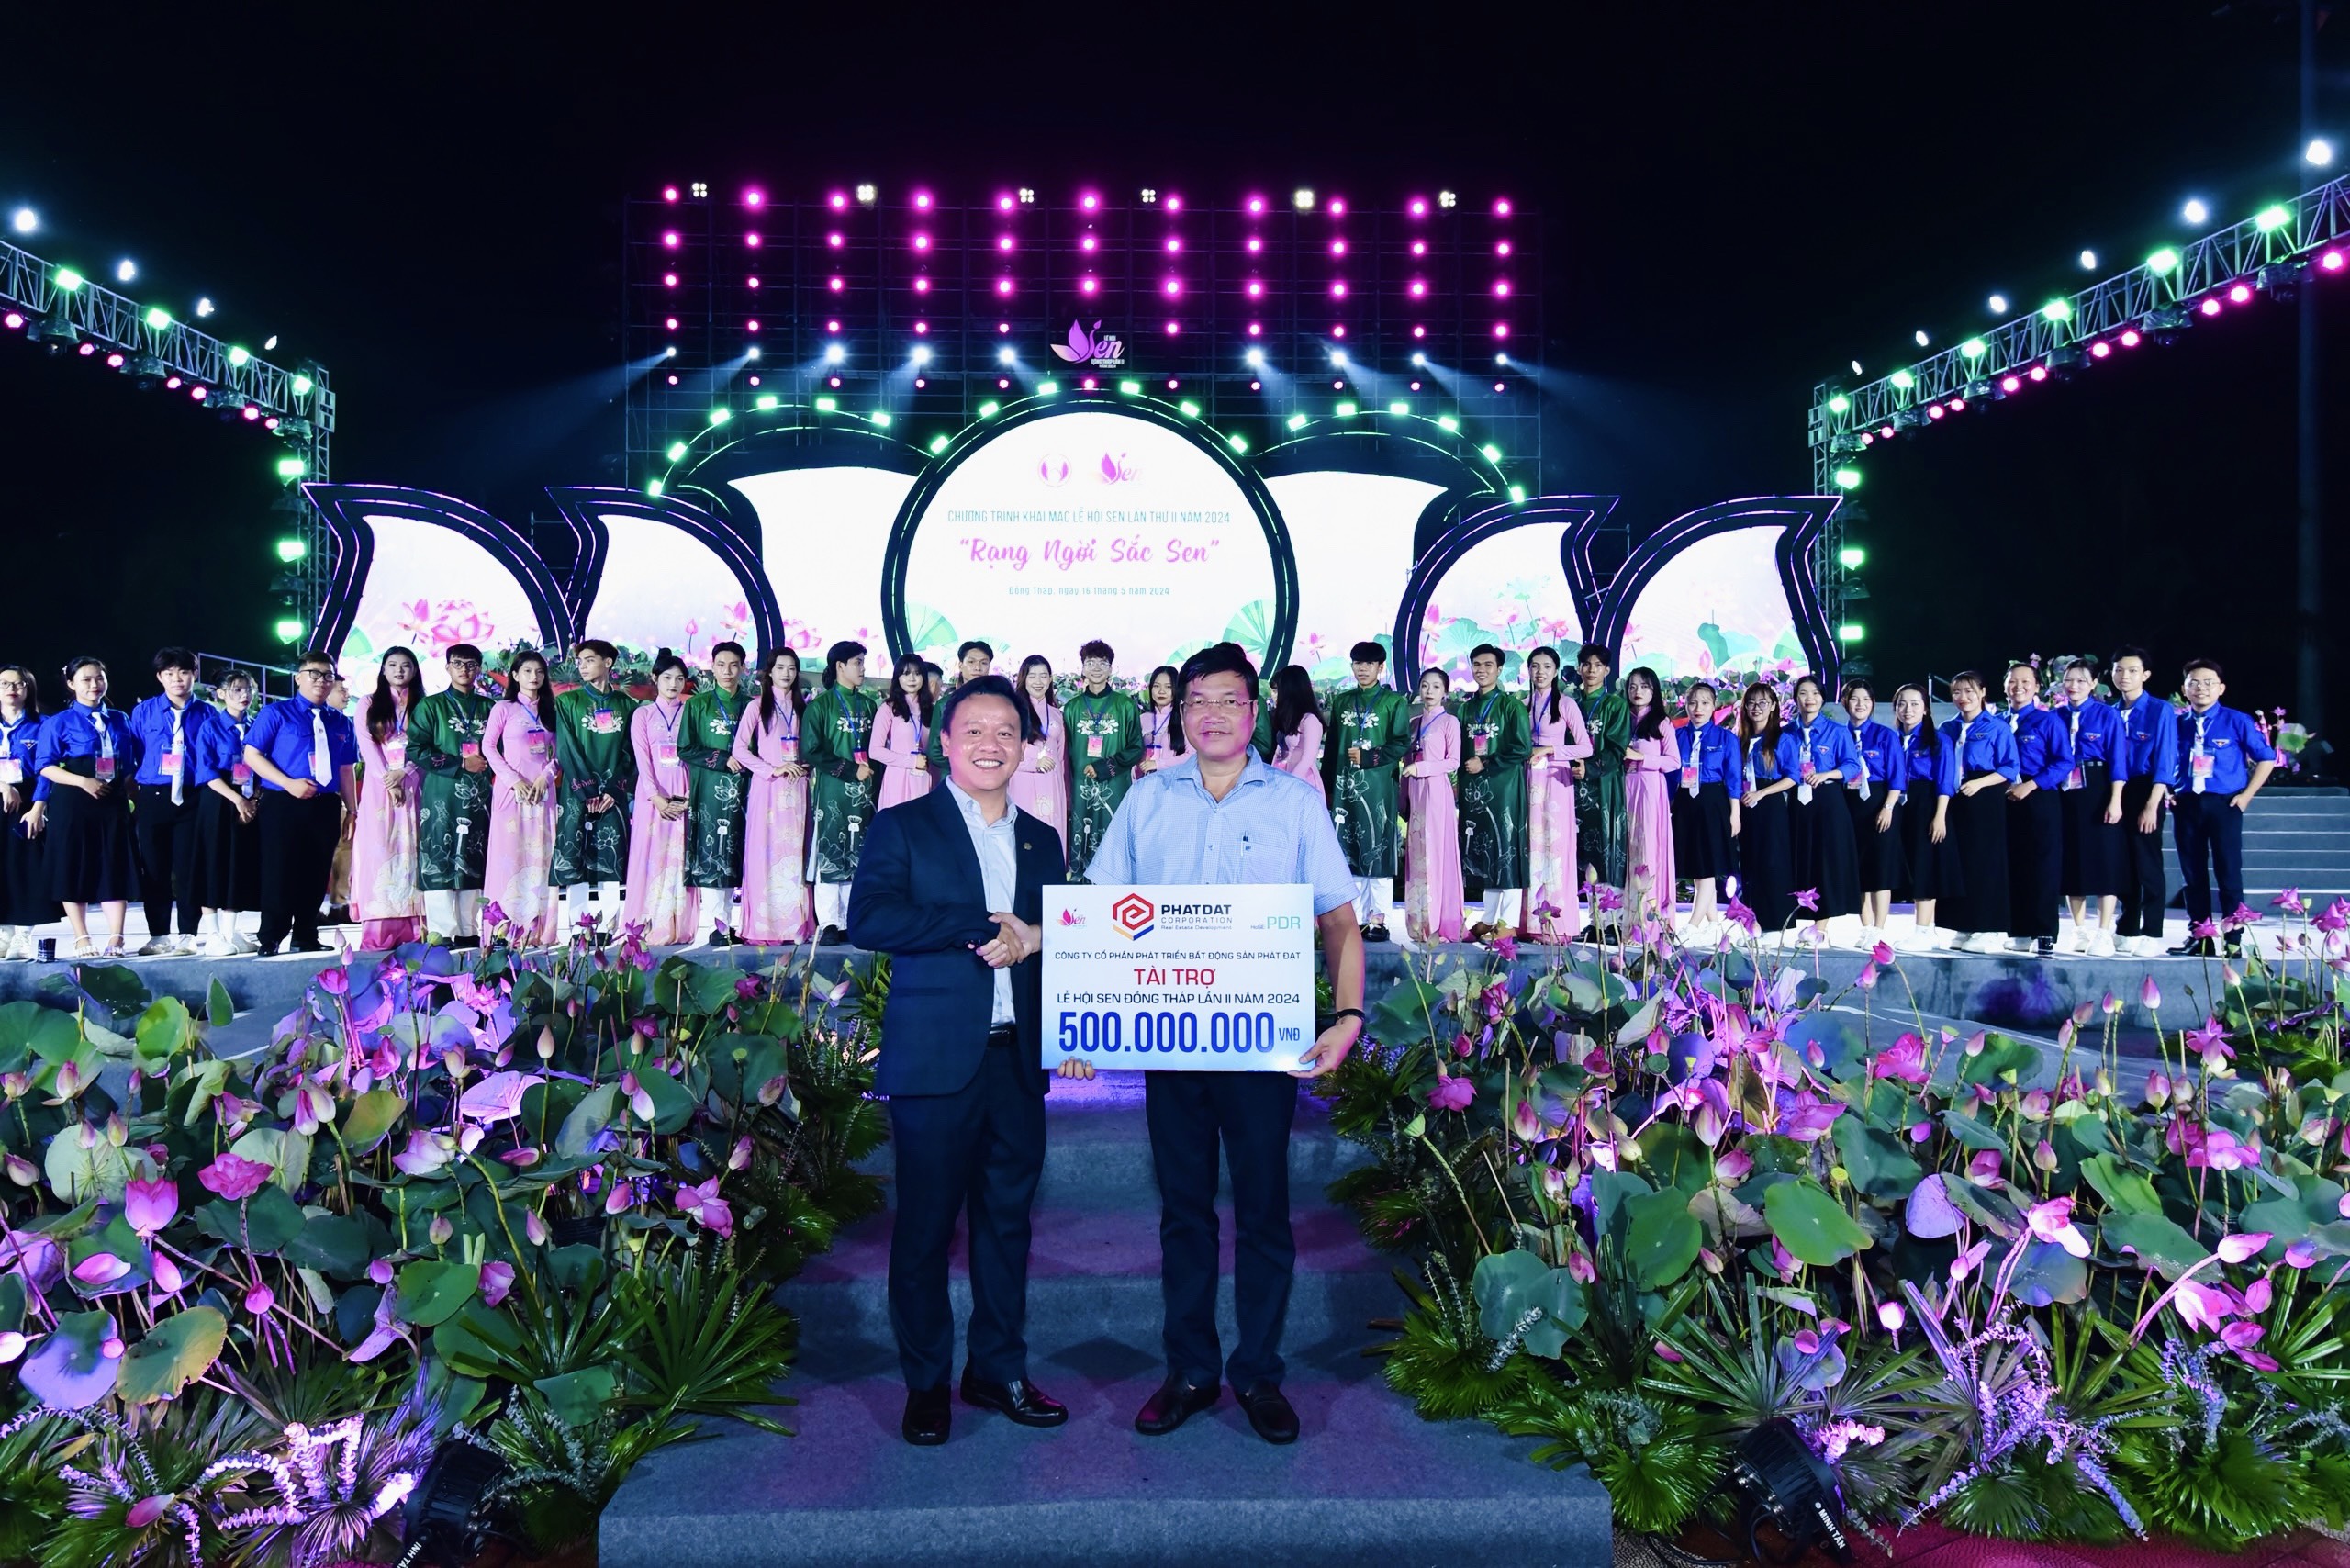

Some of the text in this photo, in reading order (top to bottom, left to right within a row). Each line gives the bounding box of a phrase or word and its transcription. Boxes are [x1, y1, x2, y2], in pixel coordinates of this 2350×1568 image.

[1023, 510, 1046, 522] KHAI
[1106, 510, 1125, 523] SEN
[1171, 511, 1177, 523] II
[1204, 511, 1230, 523] 2024
[1044, 538, 1098, 571] Ngời
[1110, 534, 1153, 563] Sắc
[1082, 587, 1091, 595] 16
[1121, 587, 1125, 595] 5
[1149, 587, 1169, 595] 2024
[1161, 904, 1232, 915] PHATDAT
[1267, 916, 1301, 929] PDR
[1055, 950, 1080, 959] CÔNG
[1208, 951, 1234, 961] ĐỘNG
[1134, 965, 1216, 989] TÀI TRỢ
[1073, 991, 1093, 1005] HỘI
[1096, 993, 1121, 1003] SEN
[1162, 991, 1194, 1003] THÁP
[1225, 994, 1231, 1003] II
[1235, 992, 1264, 1003] NĂM
[1267, 993, 1300, 1004] 2024
[1059, 1011, 1301, 1053] 500.000.000 VNĐ
[1818, 1508, 1836, 1532] MINH
[407, 1541, 422, 1559] INH
